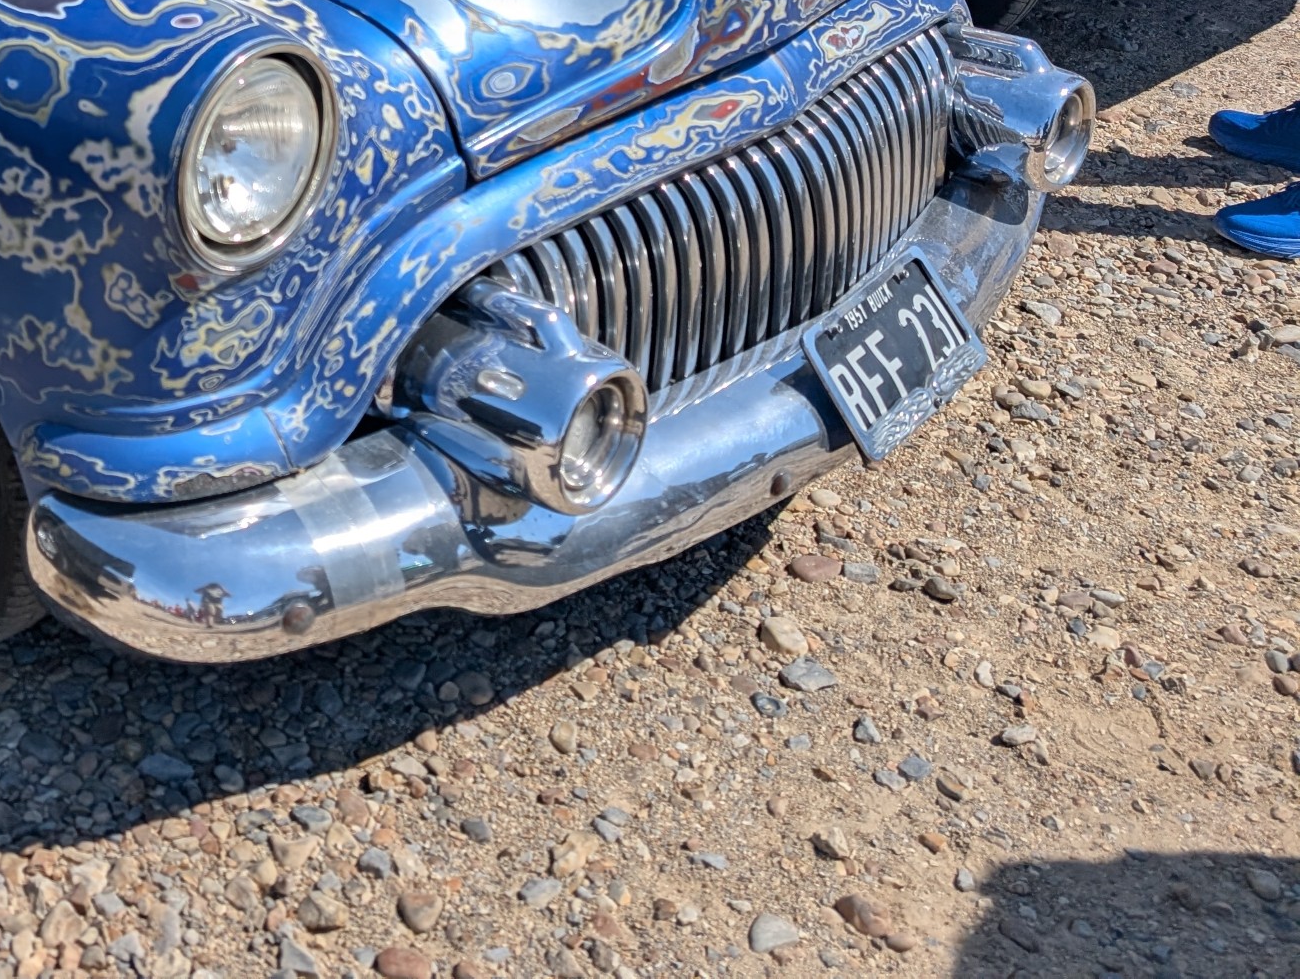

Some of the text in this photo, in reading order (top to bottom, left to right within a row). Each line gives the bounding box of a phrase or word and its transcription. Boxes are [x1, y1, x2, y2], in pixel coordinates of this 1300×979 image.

[844, 282, 894, 331] 1951 BUICK
[828, 284, 966, 432] RFF 231
